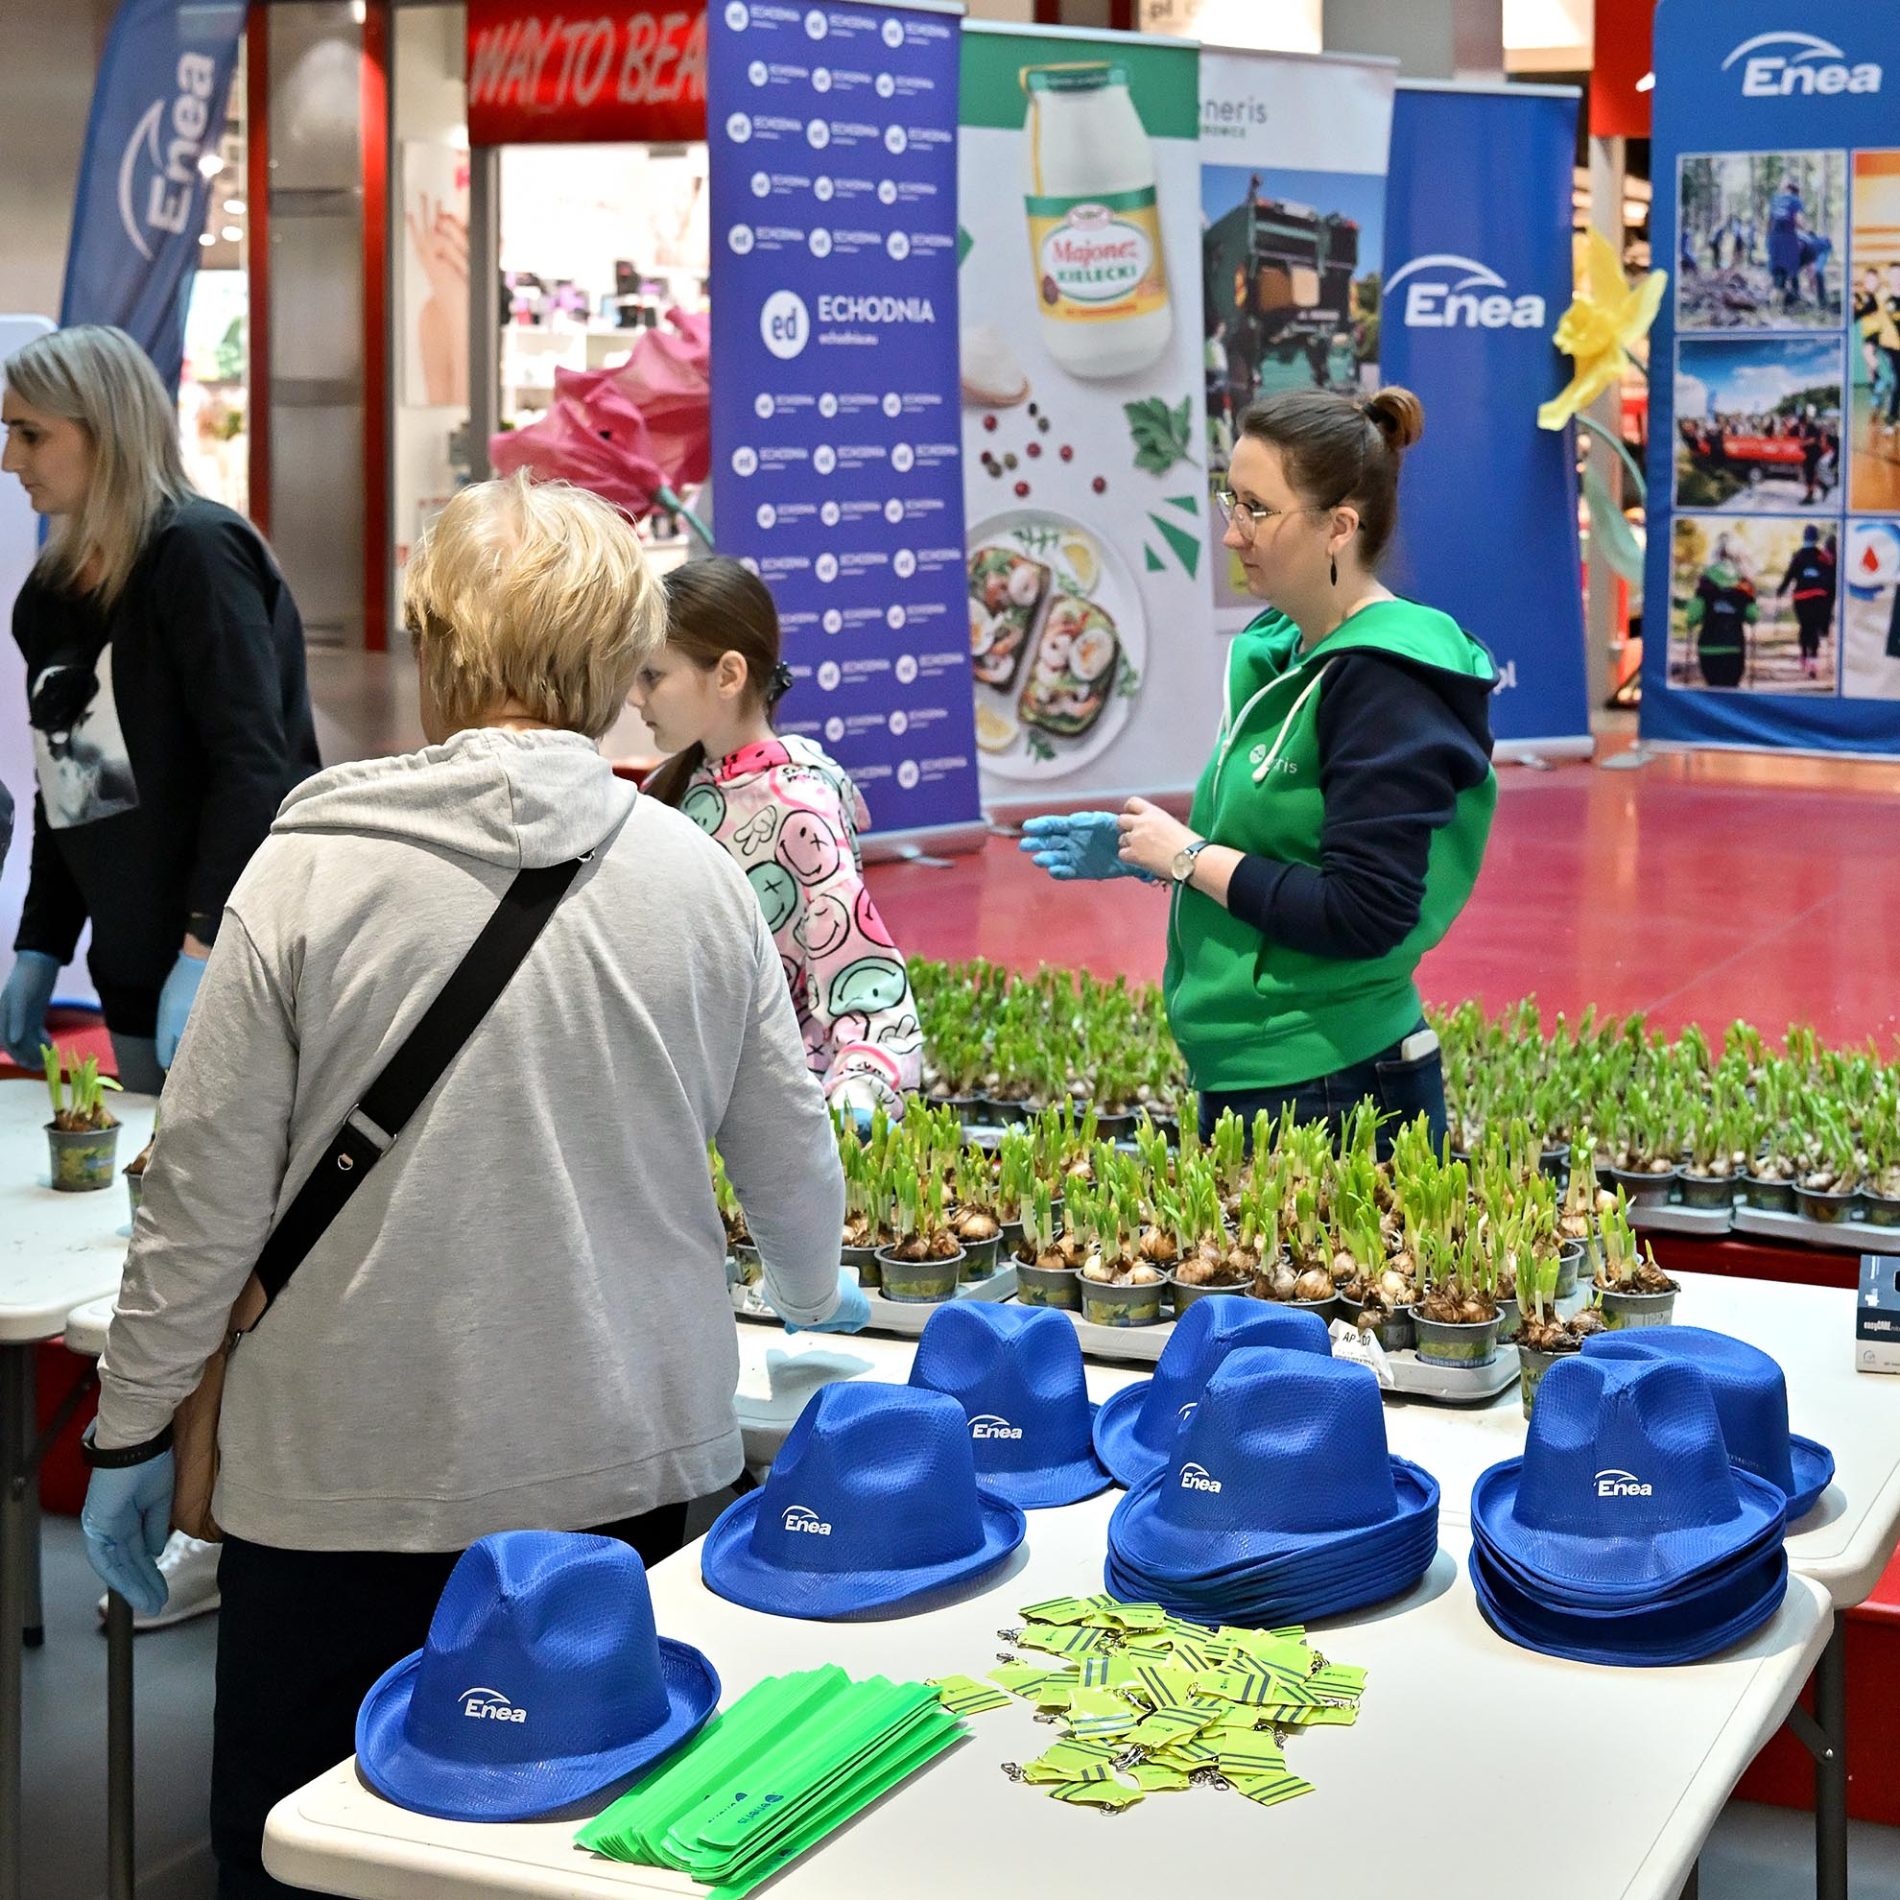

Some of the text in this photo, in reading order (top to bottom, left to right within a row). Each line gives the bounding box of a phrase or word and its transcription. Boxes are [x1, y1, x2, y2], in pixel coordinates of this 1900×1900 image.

[558, 15, 616, 107] TO
[617, 11, 708, 105] BEA
[1742, 56, 1882, 97] Enea
[1205, 96, 1267, 124] neris
[146, 52, 215, 234] Enea
[1057, 266, 1136, 283] KIELECKI
[771, 295, 936, 341] ed ECHODNIA
[1404, 282, 1546, 328] Enea
[1492, 660, 1518, 696] pl
[972, 1424, 1023, 1439] Enea
[1181, 1472, 1222, 1494] Enea
[1598, 1480, 1653, 1497] Enea
[785, 1514, 832, 1536] Enea
[464, 1698, 527, 1723] Enea
